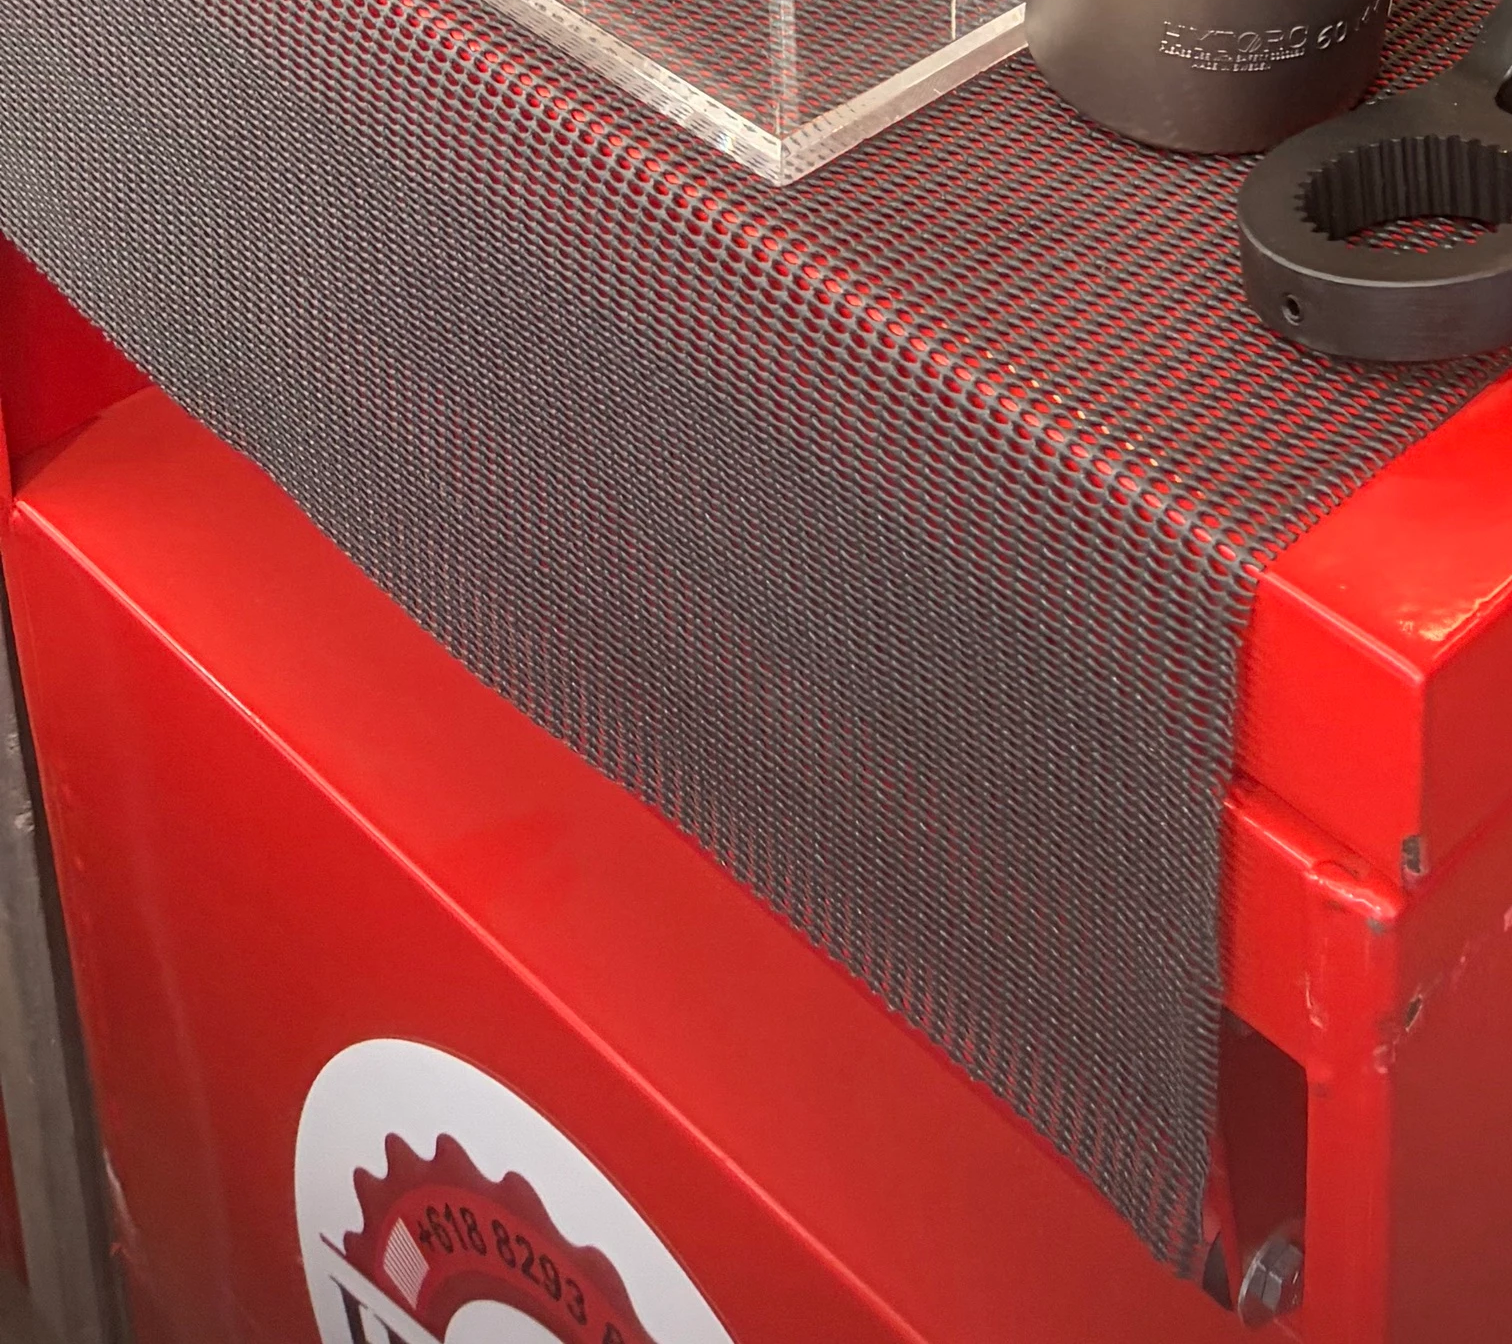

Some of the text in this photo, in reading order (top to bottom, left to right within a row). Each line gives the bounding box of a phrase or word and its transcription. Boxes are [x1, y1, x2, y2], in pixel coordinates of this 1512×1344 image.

[1316, 21, 1347, 50] 60
[417, 1203, 487, 1256] +618
[491, 1219, 587, 1326] 8293
